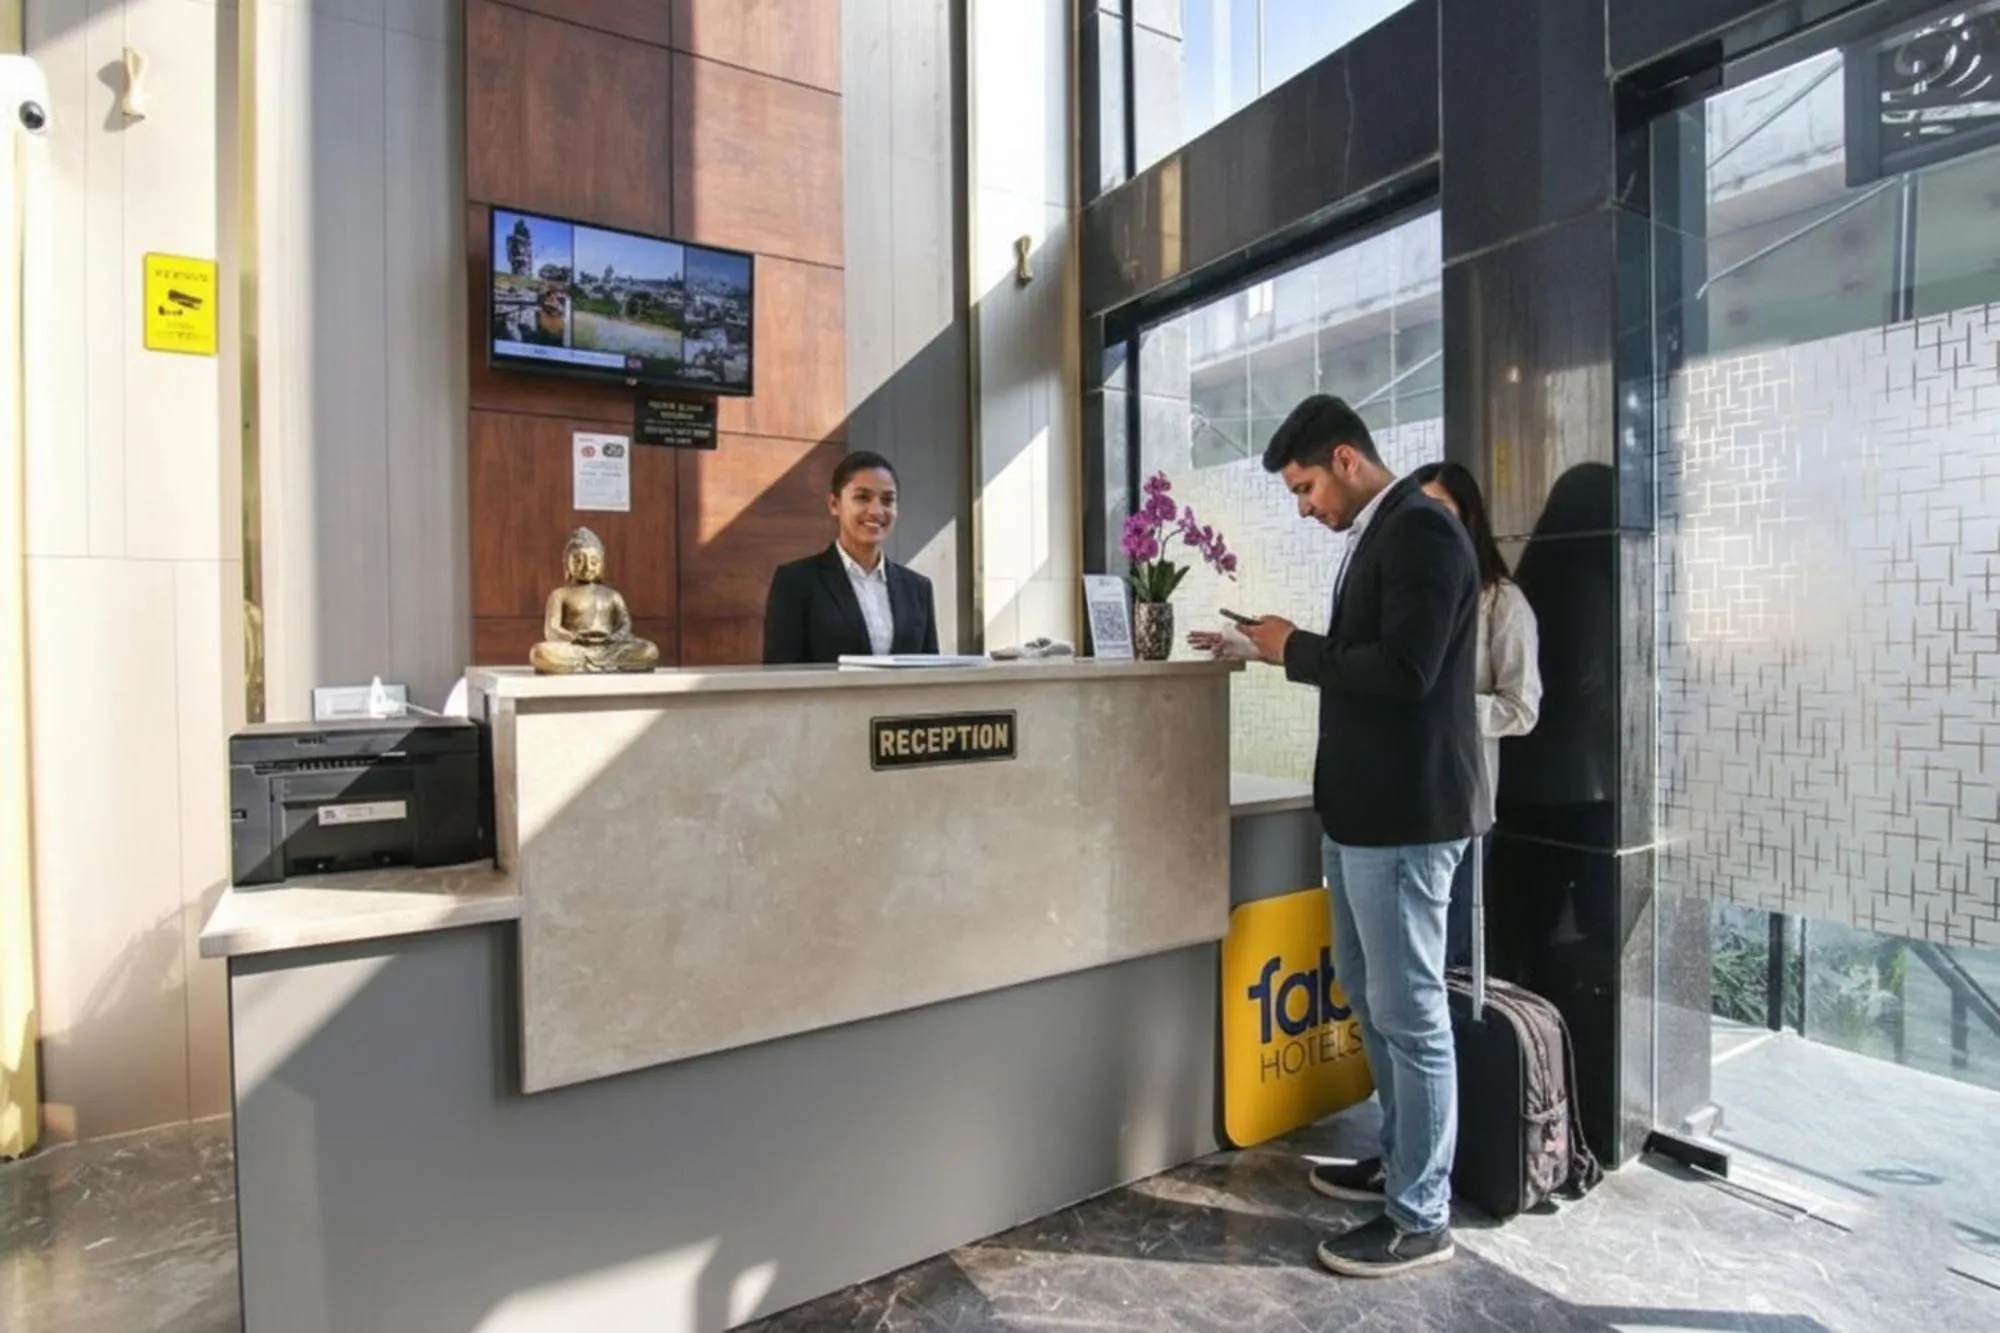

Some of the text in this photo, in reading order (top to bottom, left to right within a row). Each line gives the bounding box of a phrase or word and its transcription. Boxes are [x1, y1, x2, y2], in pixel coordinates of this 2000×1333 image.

[879, 723, 1009, 757] RECEPTION
[1247, 945, 1353, 1044] fab
[1260, 1021, 1364, 1084] HOTELS
